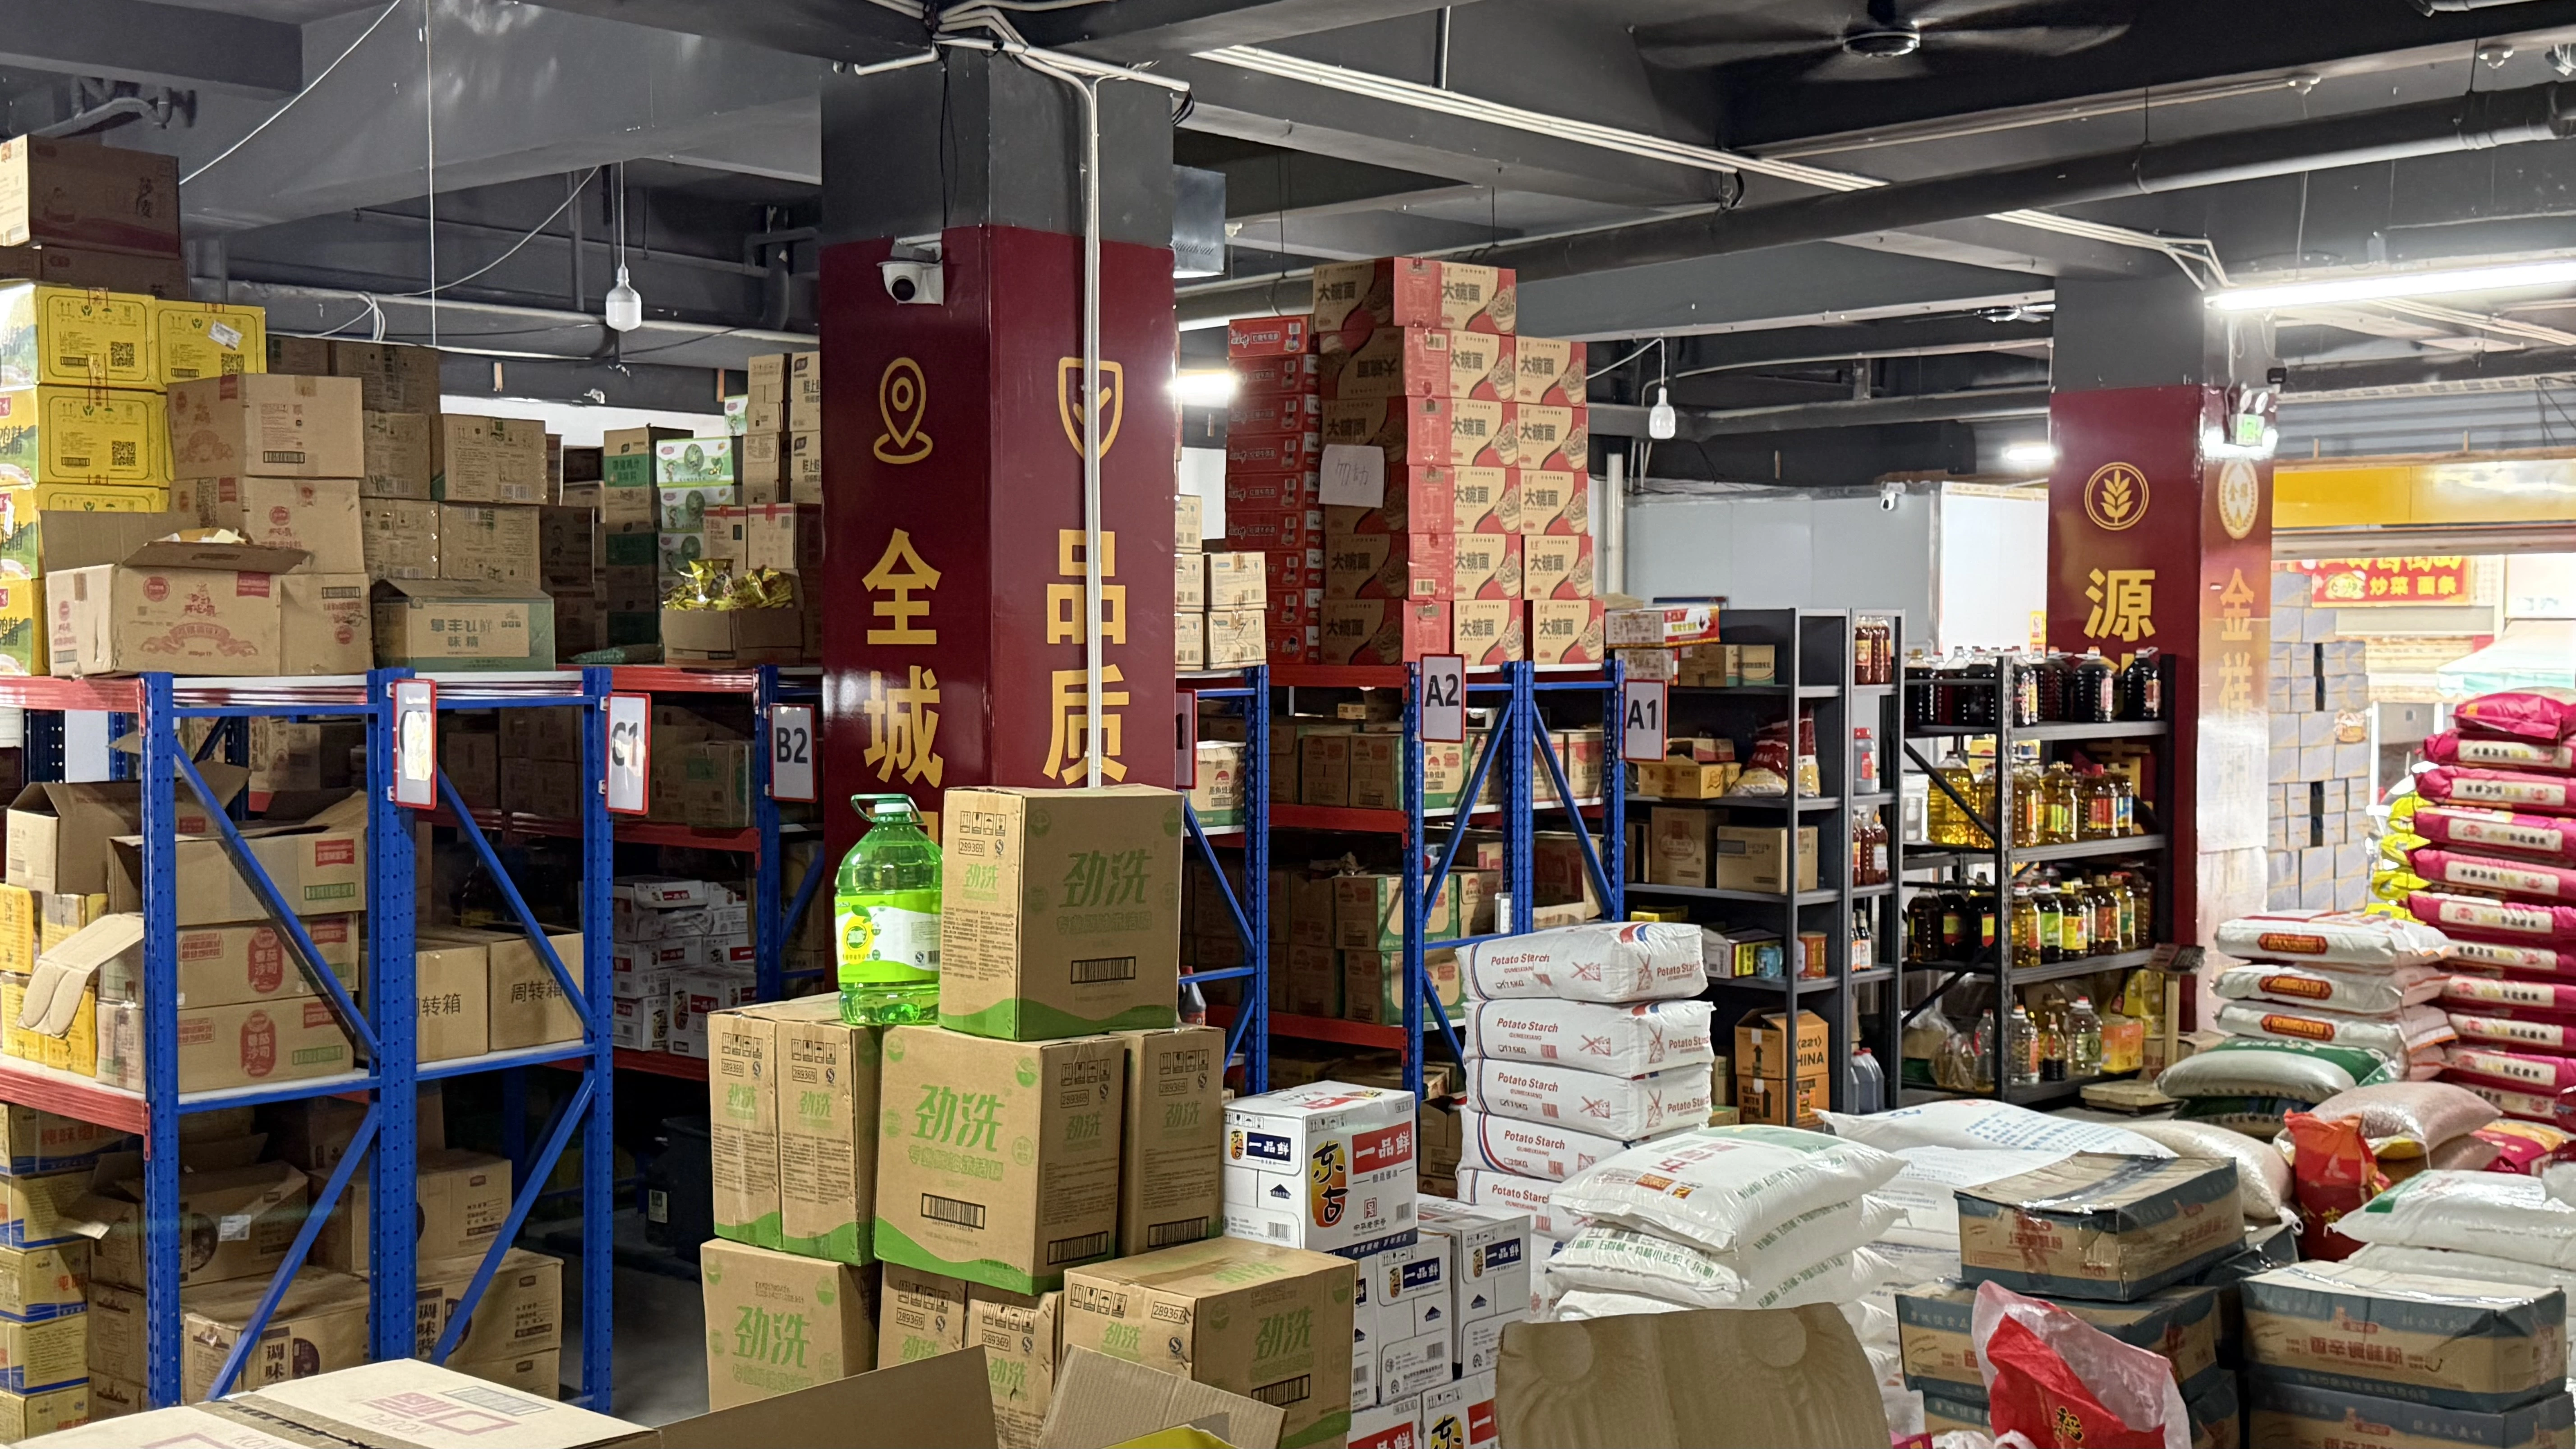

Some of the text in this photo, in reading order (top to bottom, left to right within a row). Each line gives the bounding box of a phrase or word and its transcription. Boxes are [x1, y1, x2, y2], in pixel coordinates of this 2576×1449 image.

[2370, 576, 2408, 595] 炒菜
[1043, 529, 1129, 785] 品质
[862, 529, 943, 843] 全城
[1425, 674, 1459, 707] A2
[1627, 699, 1656, 730] A1
[612, 722, 640, 766] C1
[777, 727, 808, 763] B2
[964, 863, 999, 890] 劲洗
[1058, 848, 1154, 908] 劲洗
[1491, 953, 1550, 966] Potato Starch
[1657, 965, 1680, 977] Potato
[511, 978, 563, 1003] 周转箱
[1497, 1018, 1558, 1033] Potato Starch
[1669, 1038, 1692, 1050] Potato
[1796, 1051, 1824, 1067] HINA
[1498, 1072, 1558, 1092] Potato Starch
[911, 1084, 1006, 1152] 劲洗
[1163, 1099, 1201, 1128] 劲洗
[1668, 1101, 1691, 1114] Potato
[1066, 1111, 1102, 1141] 劲洗
[1249, 1140, 1289, 1157] 一品鲜
[1356, 1130, 1410, 1158] 一品鲜
[1505, 1130, 1565, 1150] Potato Starch
[1312, 1141, 1350, 1223] 东古
[1492, 1184, 1521, 1199] Potato
[897, 1311, 923, 1326] 289369
[1154, 1305, 1183, 1320] 289367
[733, 1306, 810, 1369] 劲洗
[983, 1333, 1009, 1348] 289369
[1103, 1320, 1142, 1352] 劲洗
[1255, 1308, 1313, 1361] 劲洗
[991, 1356, 1027, 1388] 劲洗
